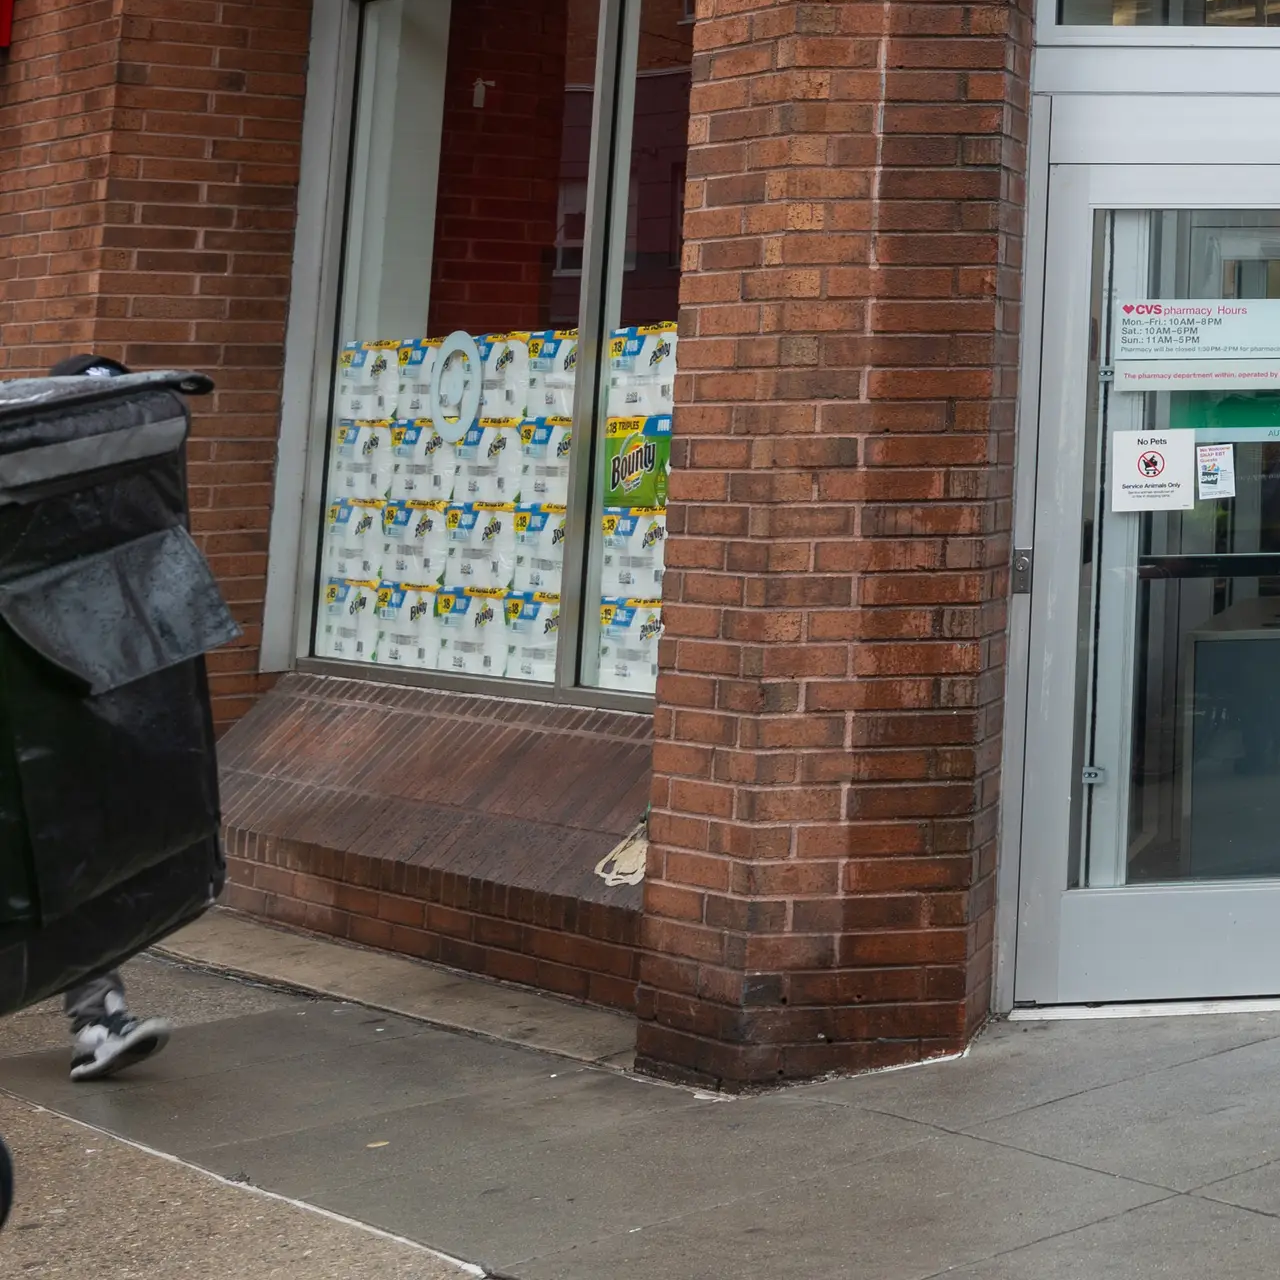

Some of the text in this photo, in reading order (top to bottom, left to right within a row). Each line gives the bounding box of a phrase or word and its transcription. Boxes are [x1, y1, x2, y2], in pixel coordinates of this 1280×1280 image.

[1135, 304, 1248, 317] CVS pharmacy Hours
[1138, 372, 1171, 380] pharmacy
[1238, 371, 1269, 379] operated
[1270, 371, 1278, 379] by
[618, 420, 640, 431] TRIPLES
[1137, 437, 1168, 446] No Pets
[611, 440, 657, 492] Bounty
